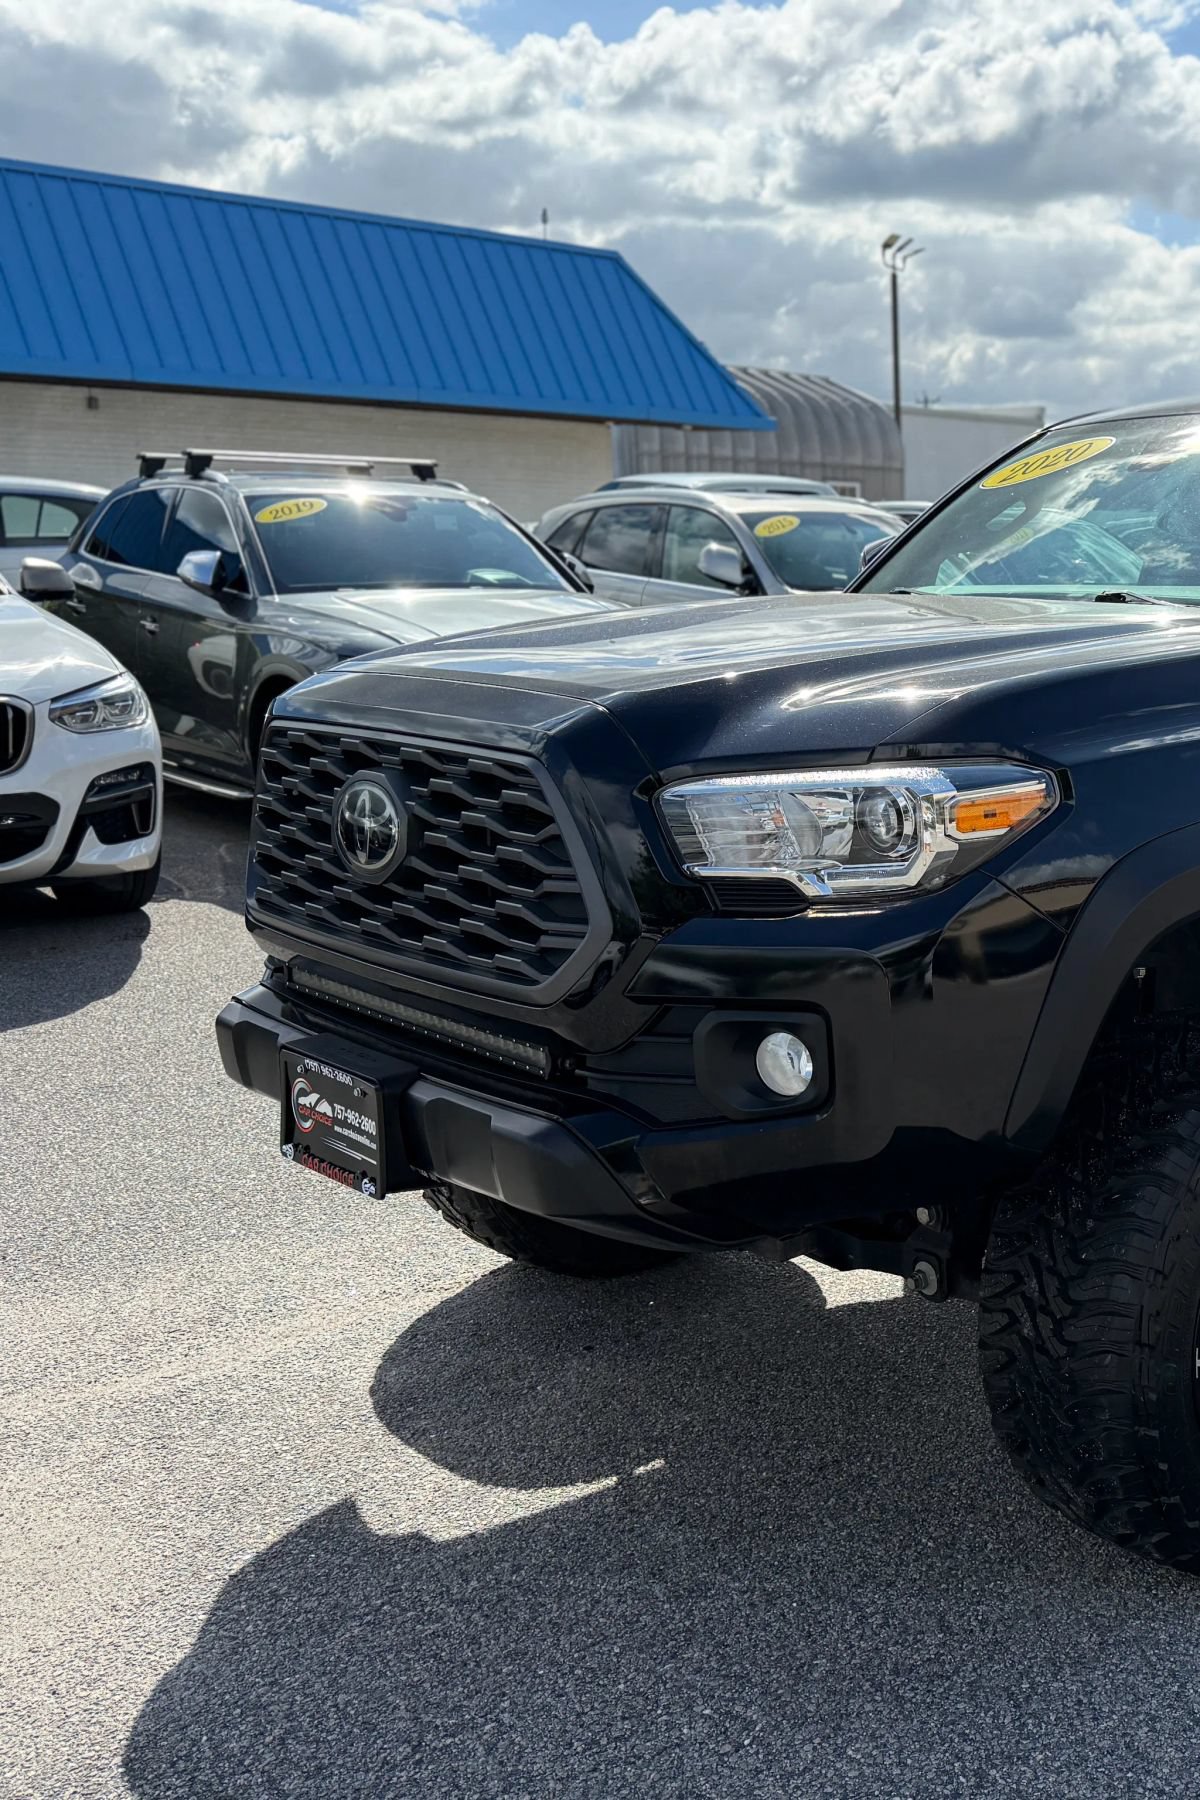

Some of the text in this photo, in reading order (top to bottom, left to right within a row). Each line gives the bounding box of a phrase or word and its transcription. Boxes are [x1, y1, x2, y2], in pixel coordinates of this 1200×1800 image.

[998, 442, 1094, 484] 2020
[269, 500, 314, 520] 2019
[321, 1064, 353, 1086] 962-2600
[298, 1105, 334, 1127] CAR CHOICE
[333, 1103, 377, 1136] 757-962-2600
[301, 1153, 355, 1188] CAR CHOICE
